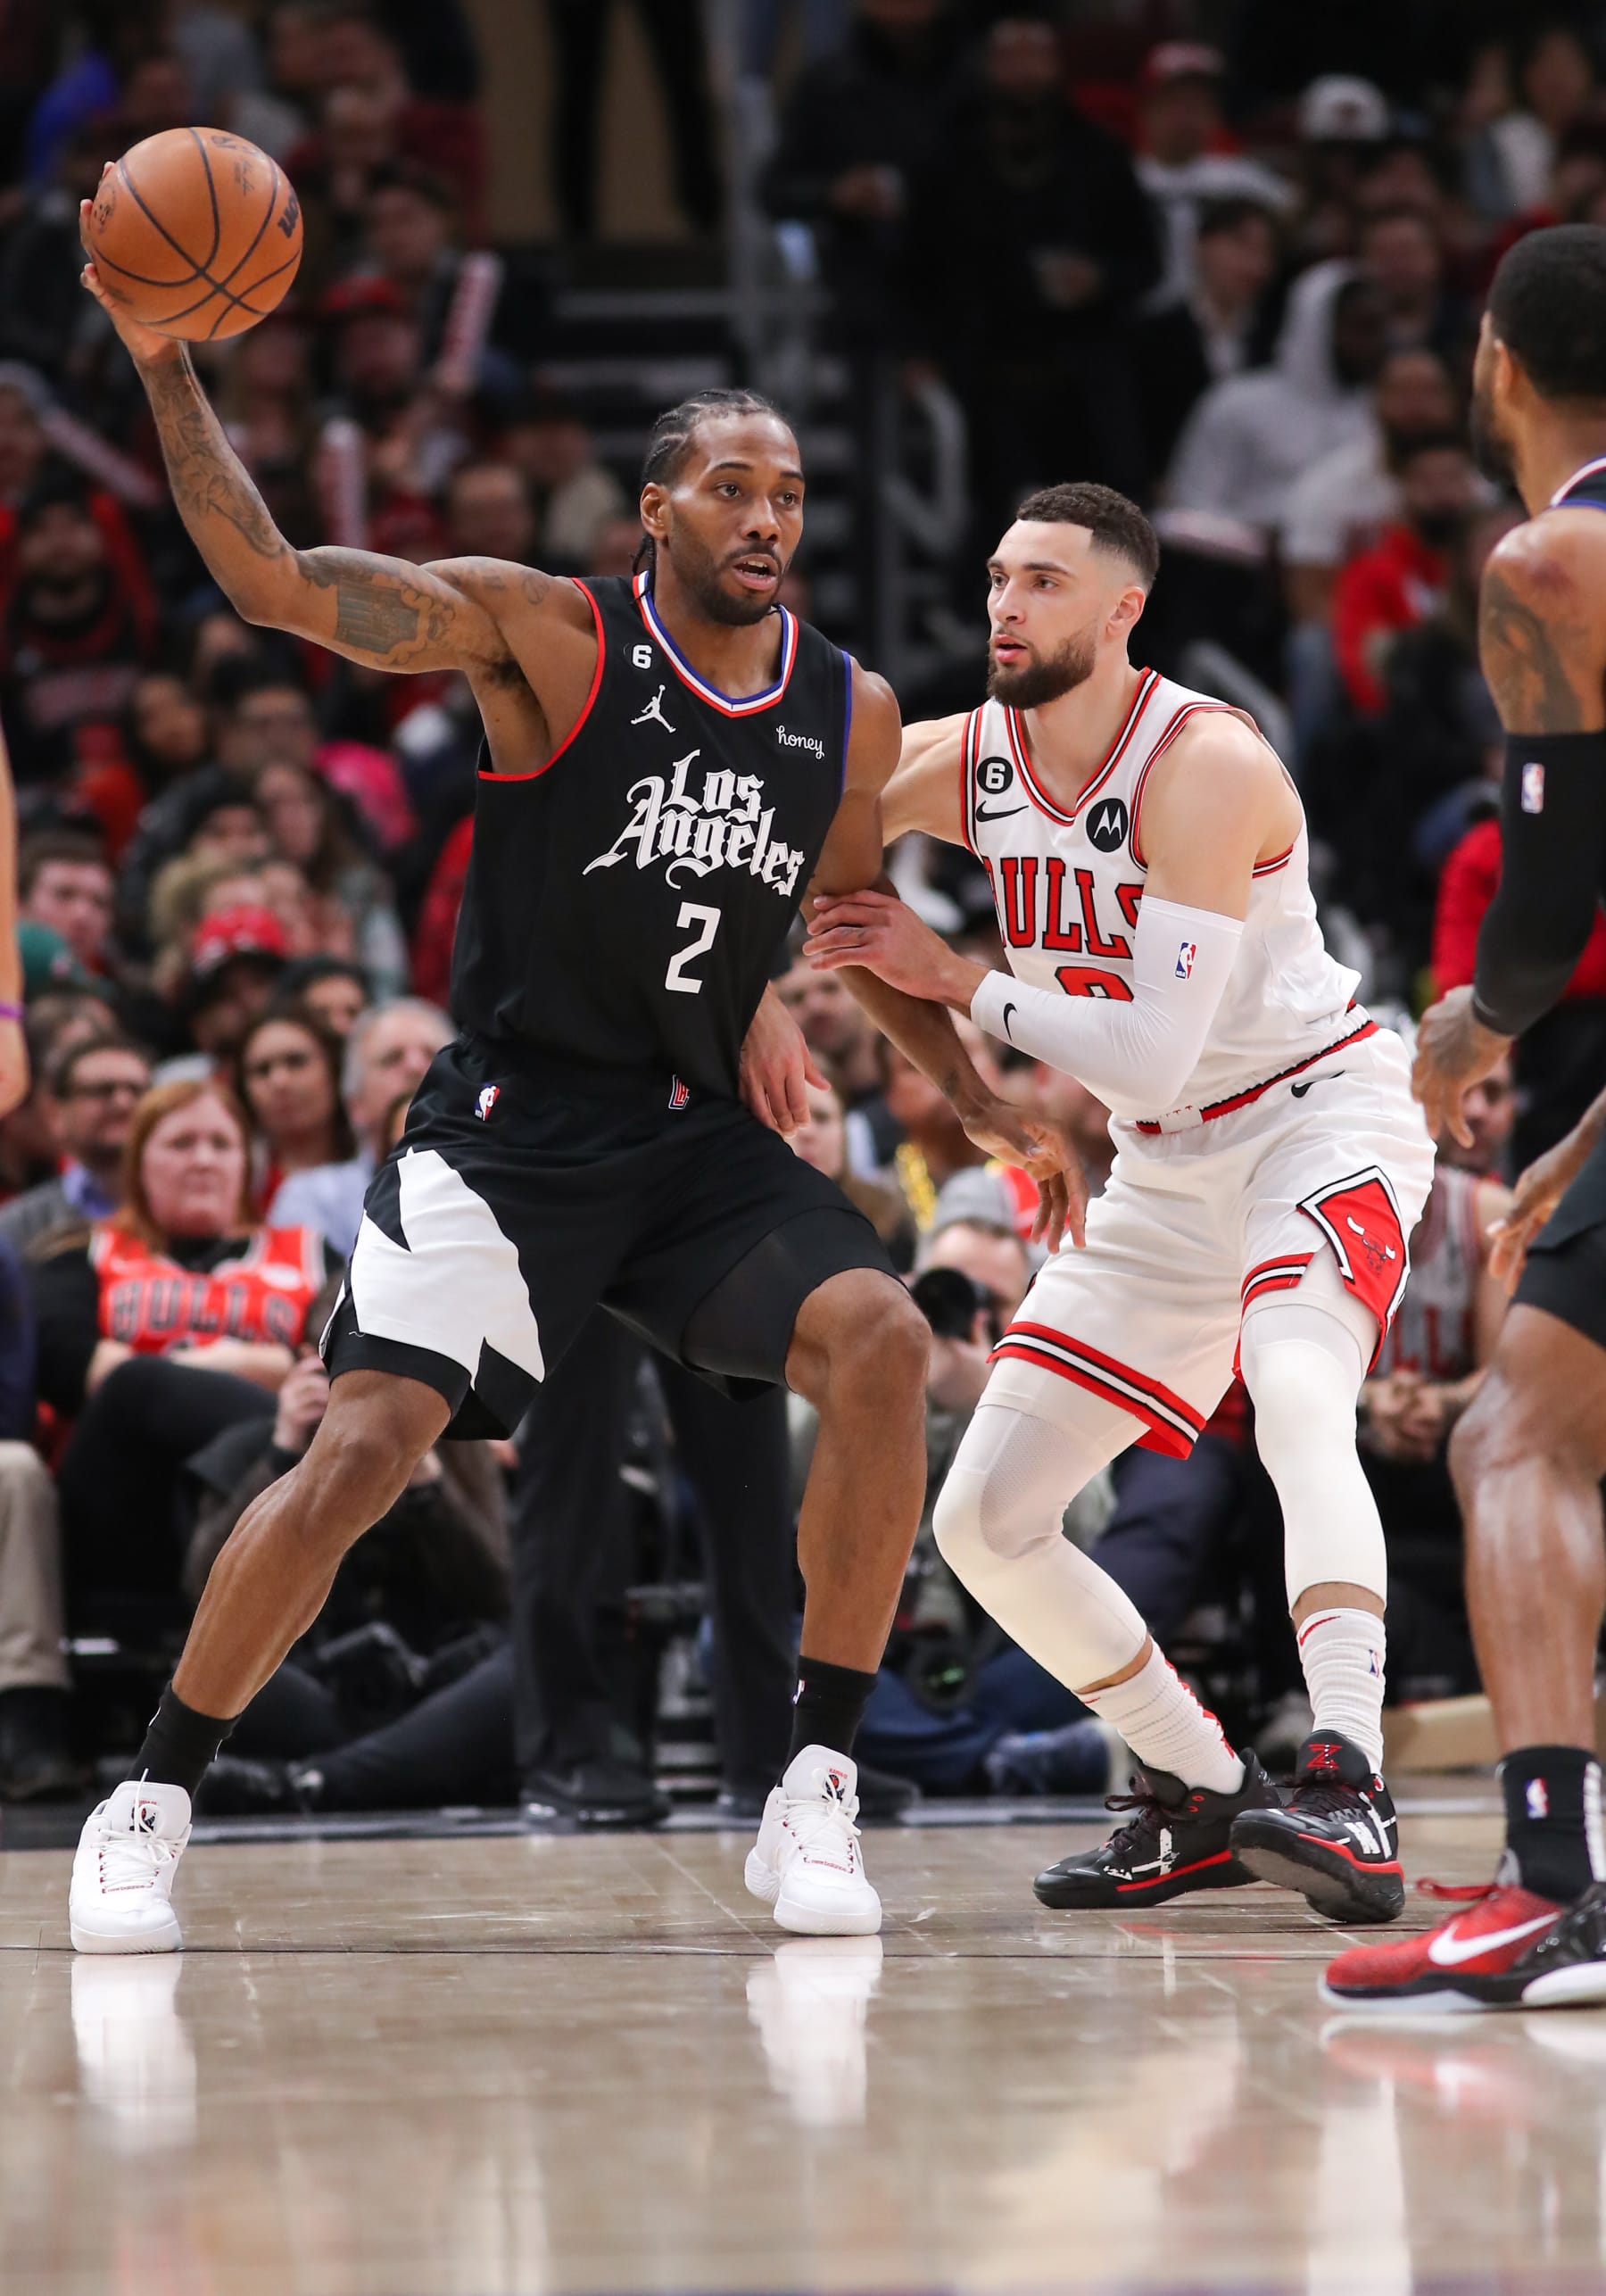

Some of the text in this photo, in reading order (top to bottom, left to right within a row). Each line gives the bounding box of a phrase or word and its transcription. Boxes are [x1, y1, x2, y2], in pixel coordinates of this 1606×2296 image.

[632, 644, 652, 669] 6
[776, 725, 824, 759] honey
[662, 749, 765, 823] Los
[985, 762, 1006, 790] 6
[582, 775, 805, 898] Angeles
[665, 901, 722, 994] 2
[111, 1277, 297, 1344] BULLS
